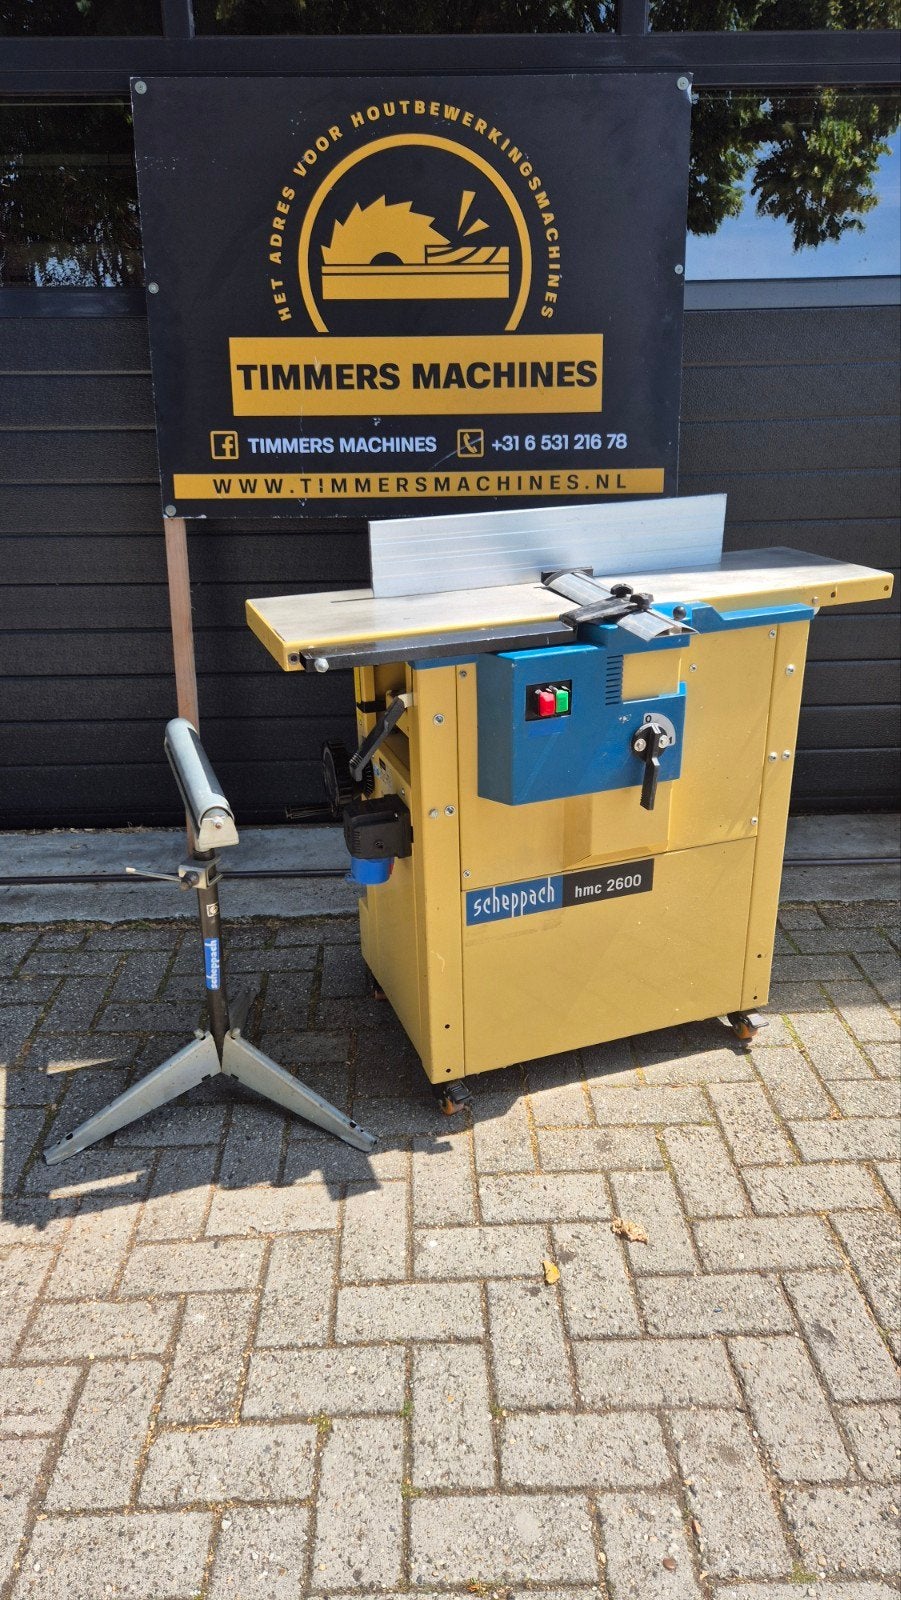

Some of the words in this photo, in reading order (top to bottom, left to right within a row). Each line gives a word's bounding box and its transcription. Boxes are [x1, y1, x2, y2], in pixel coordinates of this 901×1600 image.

[293, 125, 344, 177] VOOR
[269, 186, 296, 265] ADRES
[350, 100, 561, 318] HOUTBEWERKINGSMACHINES
[271, 278, 292, 322] HET
[237, 363, 400, 390] TIMMERS
[412, 360, 597, 389] MACHINES
[248, 437, 334, 454] TIMMERS
[340, 436, 437, 453] MACHINES
[491, 435, 519, 451] +31
[524, 435, 536, 451] 6
[541, 434, 568, 450] 531
[574, 434, 602, 450] 216
[606, 433, 628, 449] 78
[212, 474, 627, 494] WWW.TIMMERSMACHINES.NL
[473, 877, 555, 917] scheppach
[574, 881, 602, 898] hmc
[606, 874, 642, 893] 2600
